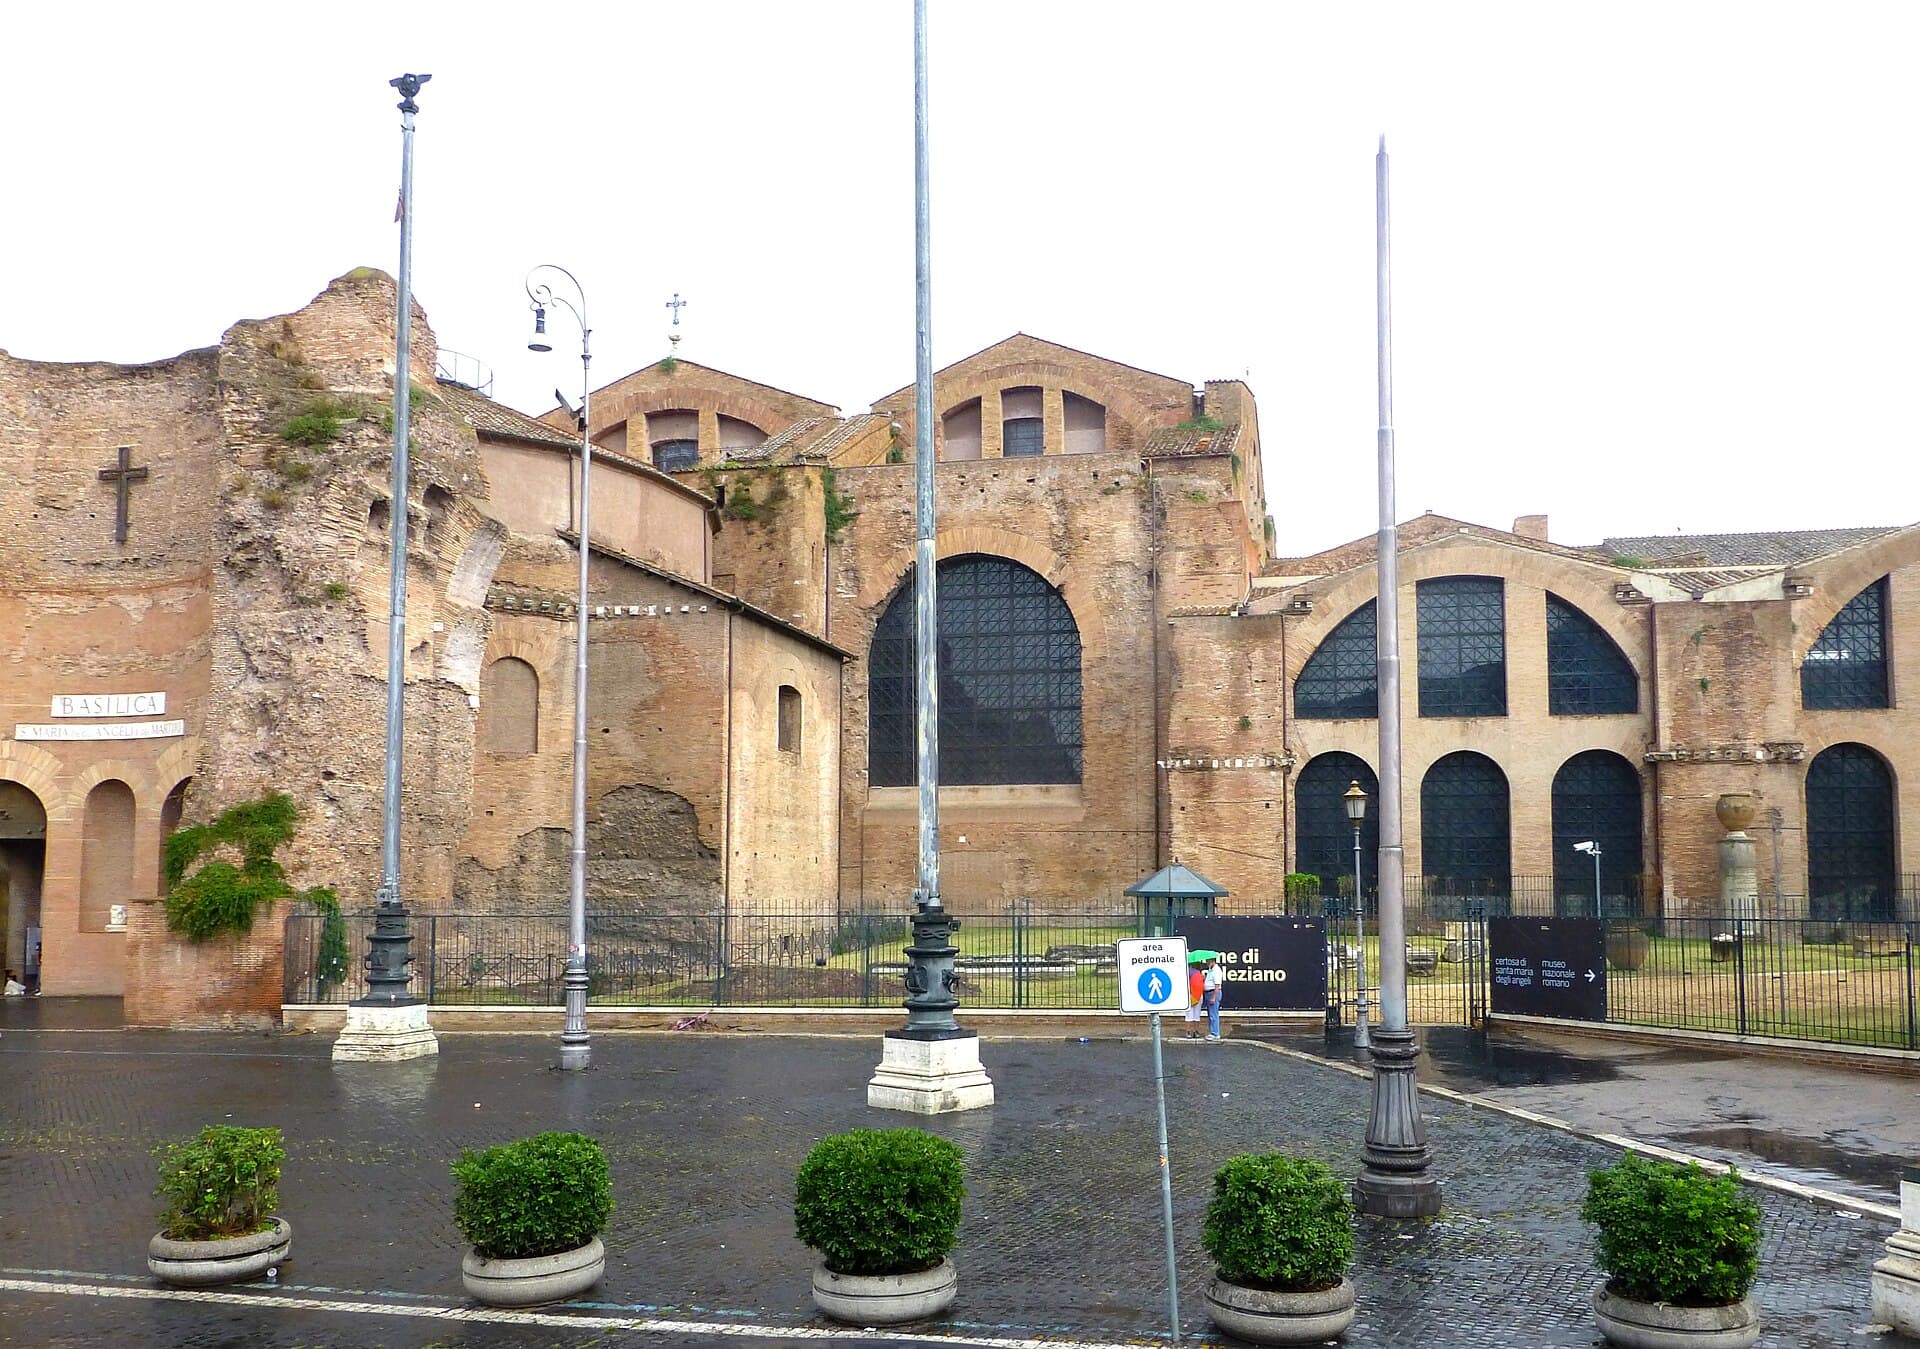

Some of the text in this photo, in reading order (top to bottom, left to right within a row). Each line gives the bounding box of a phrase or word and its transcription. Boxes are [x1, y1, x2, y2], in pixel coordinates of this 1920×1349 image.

[62, 695, 157, 714] BASILICA
[31, 727, 68, 736] MARIA
[1131, 955, 1175, 965] pedonale
[1241, 948, 1259, 964] di
[1495, 957, 1527, 967] certosa di
[1541, 960, 1566, 969] museo
[1201, 965, 1287, 982] leziano
[1495, 967, 1534, 976] santa maria
[1541, 969, 1576, 979] nazionale
[1495, 975, 1532, 987] degli angeli
[1542, 979, 1570, 988] romano
